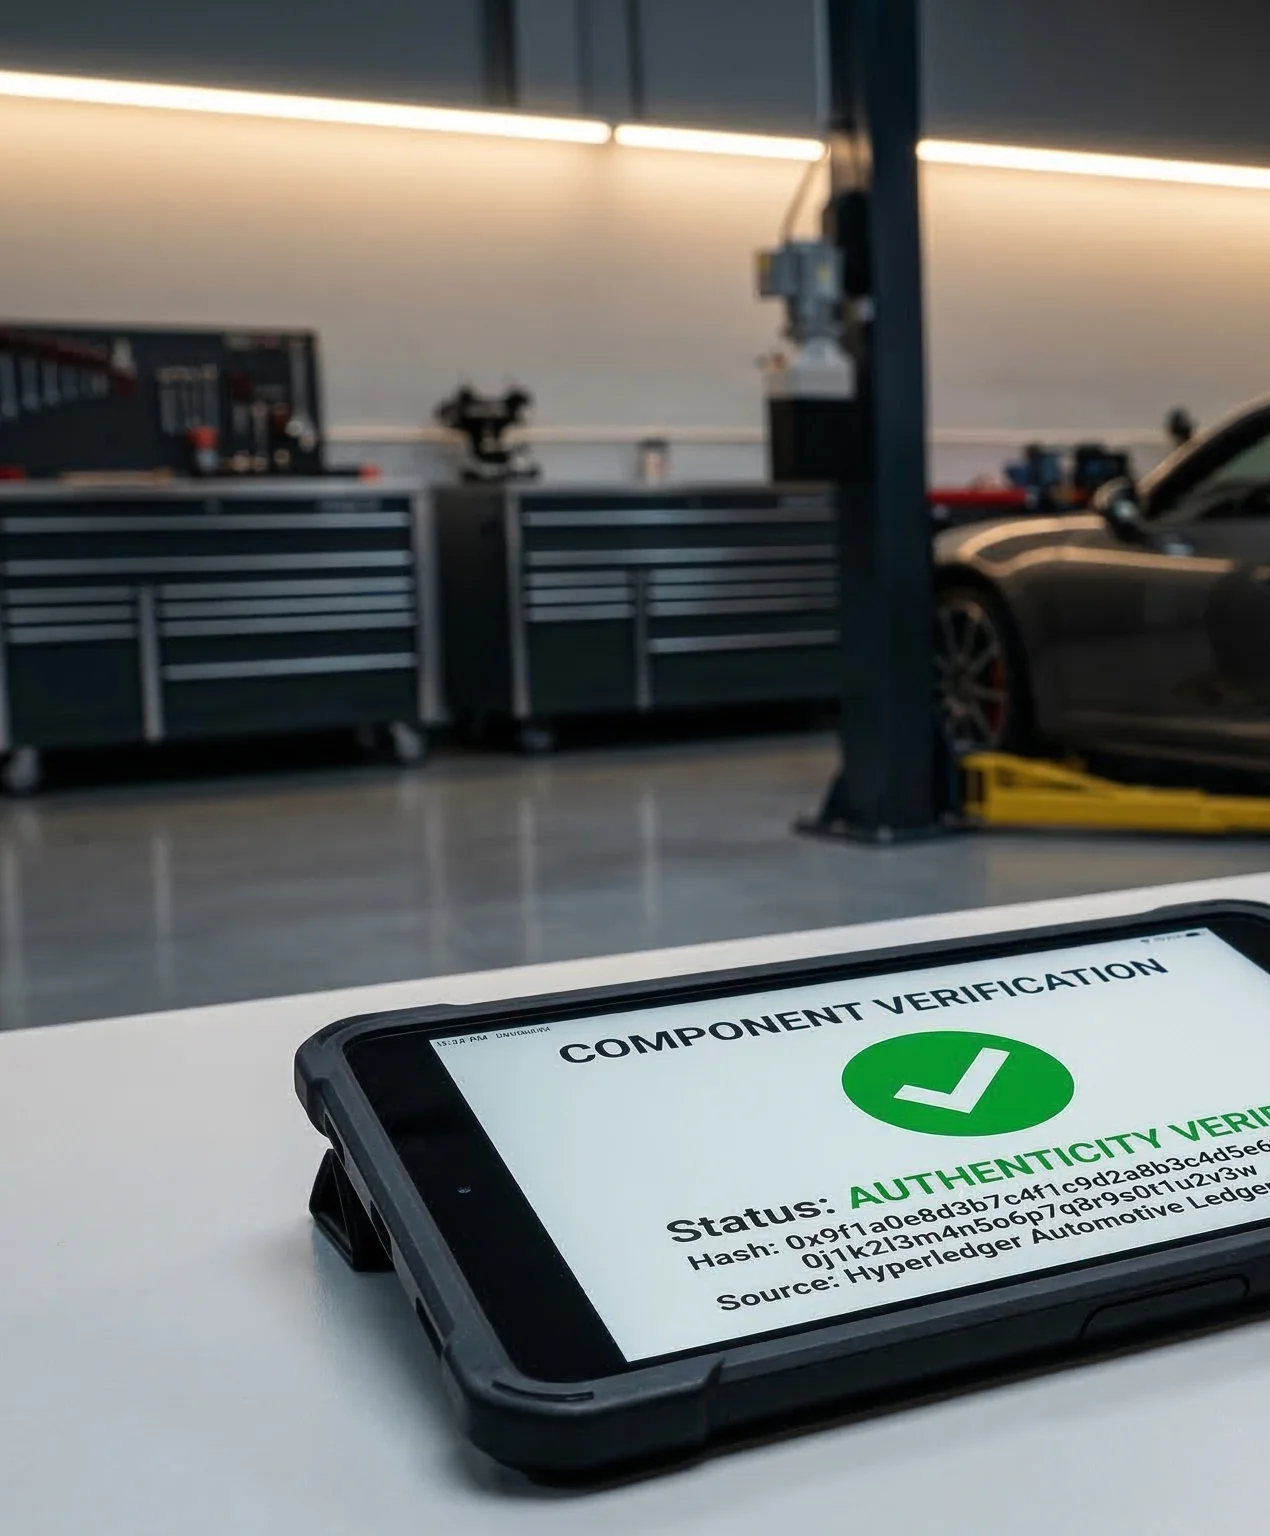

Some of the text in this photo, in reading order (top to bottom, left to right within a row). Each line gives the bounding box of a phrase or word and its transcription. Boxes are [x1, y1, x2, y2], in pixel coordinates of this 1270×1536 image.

[559, 958, 1168, 1064] COMPONENT VERIFICATION
[666, 1198, 836, 1242] Status:
[850, 1127, 1162, 1209] AUTHENTICITY
[687, 1242, 780, 1271] Hash:
[716, 1275, 840, 1311] Source:
[843, 1235, 1022, 1283] Hyperledger
[1031, 1203, 1185, 1244] Automotive
